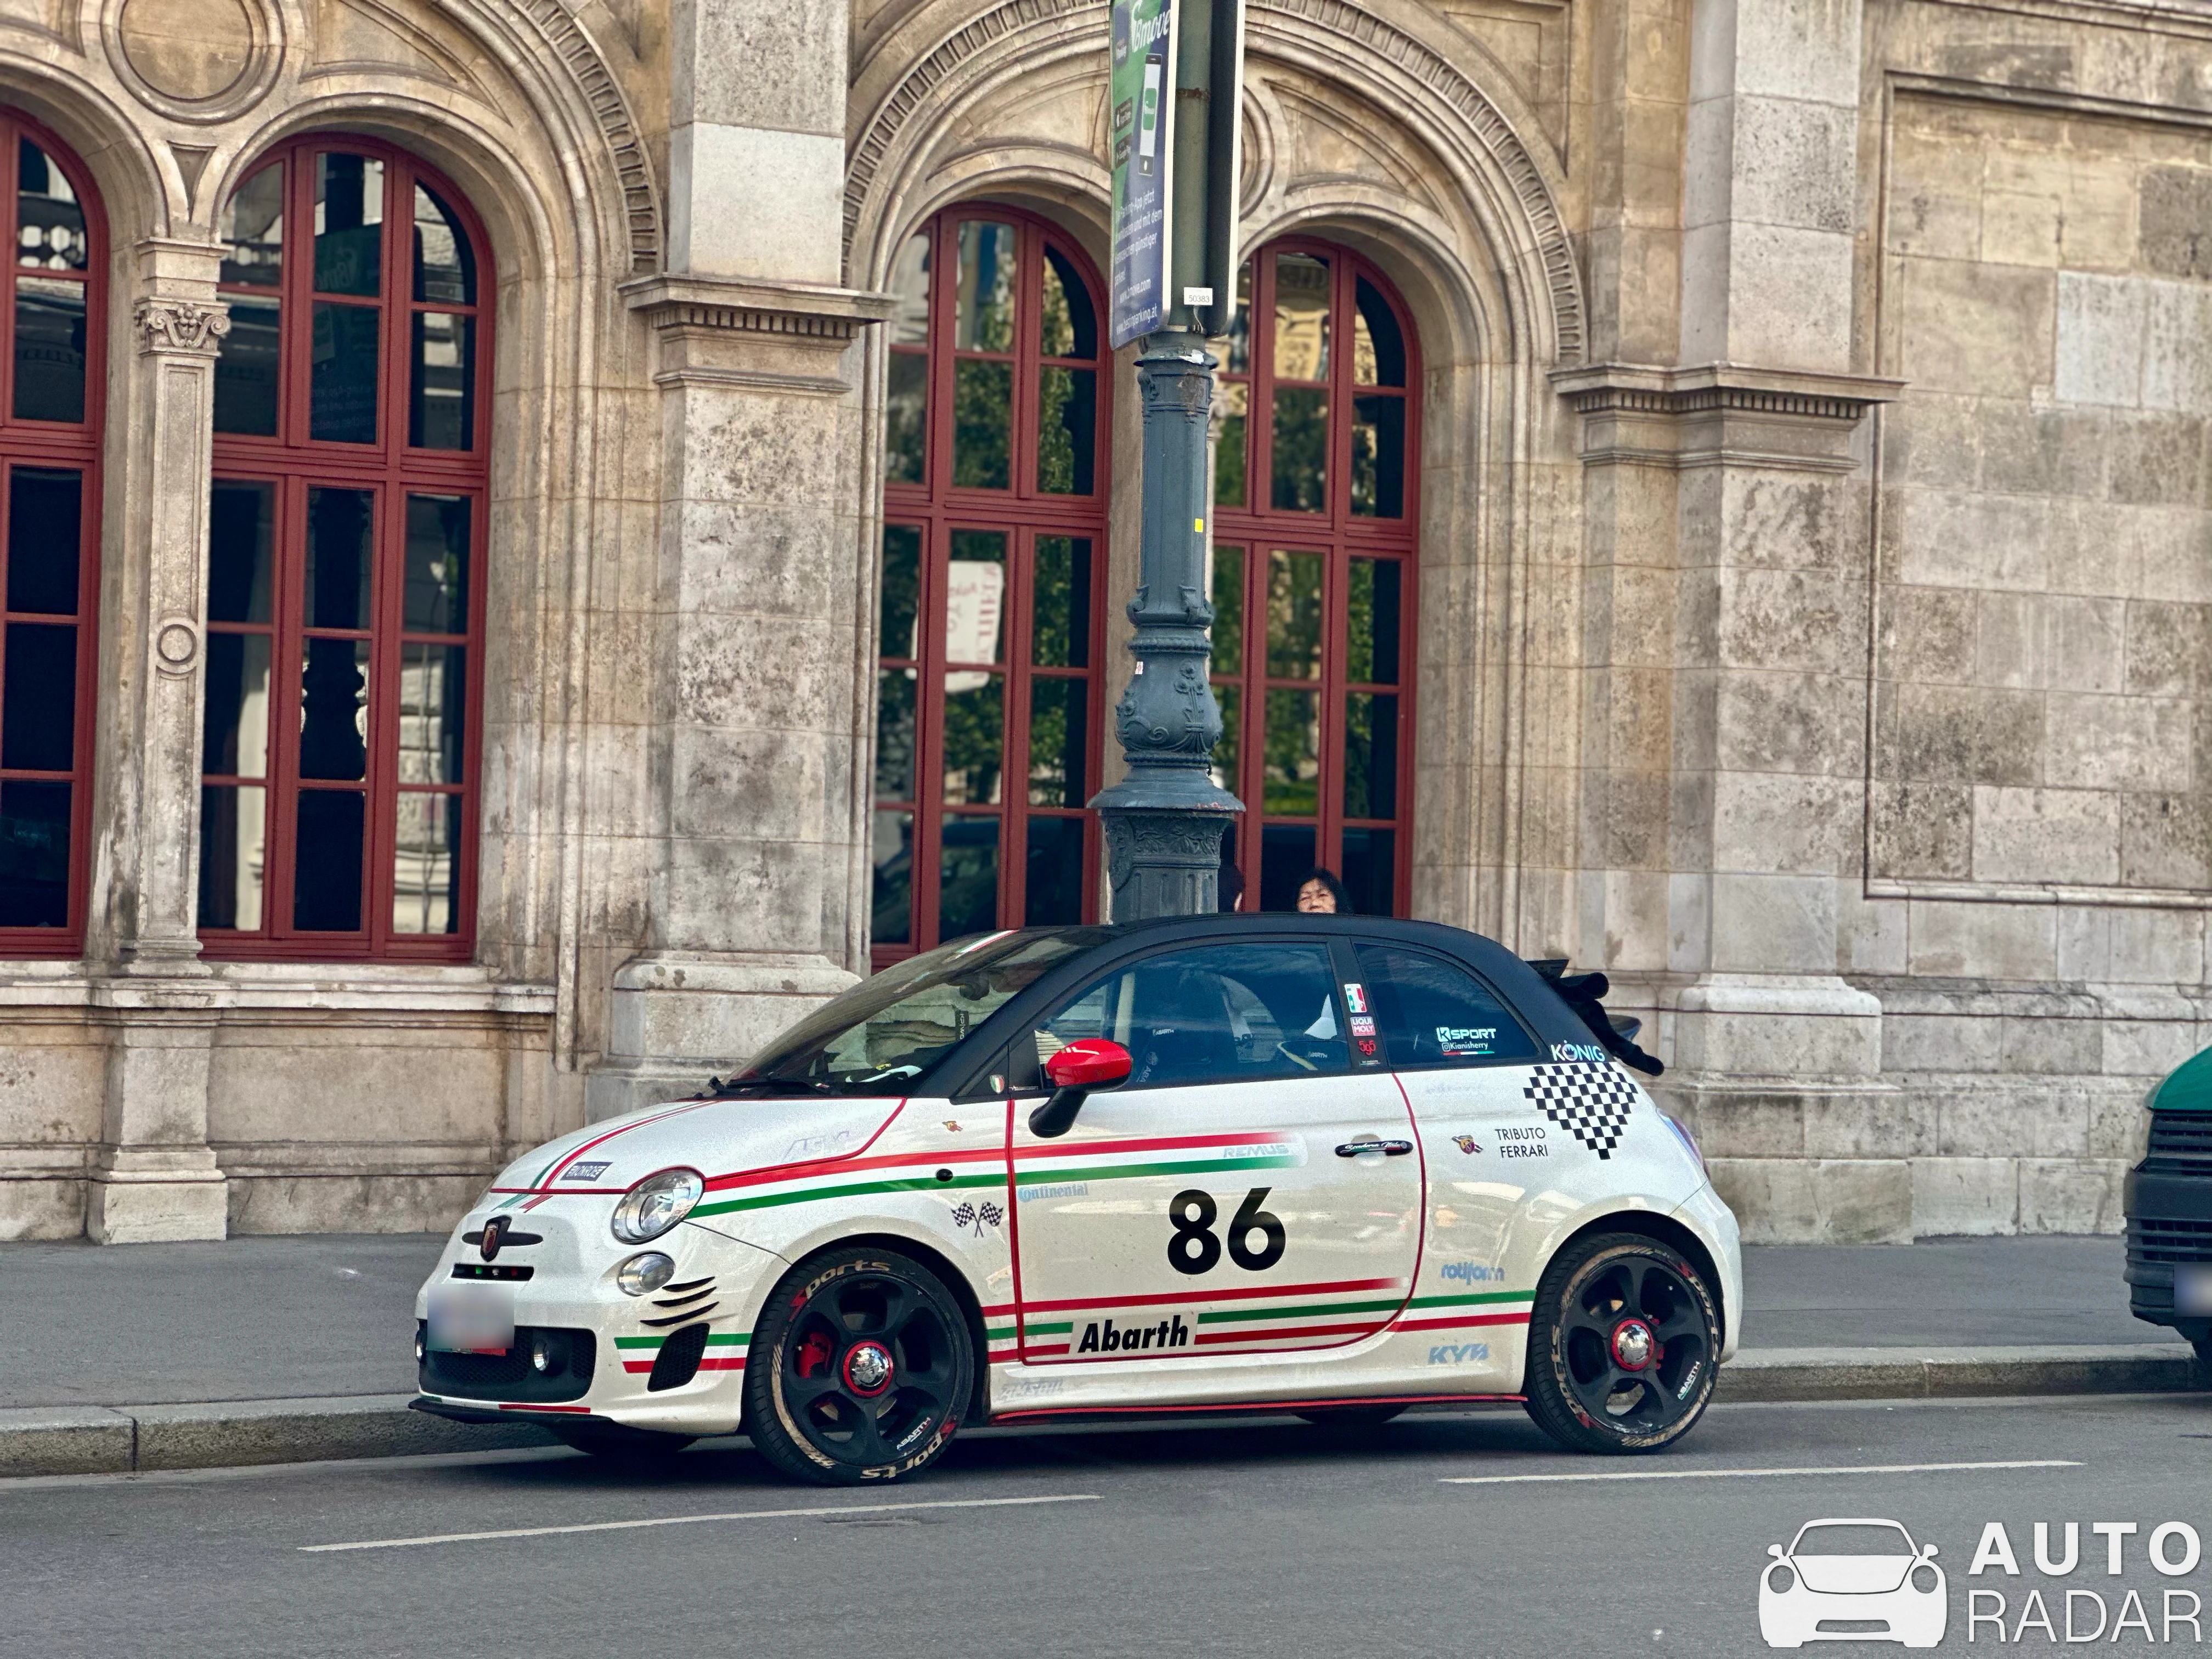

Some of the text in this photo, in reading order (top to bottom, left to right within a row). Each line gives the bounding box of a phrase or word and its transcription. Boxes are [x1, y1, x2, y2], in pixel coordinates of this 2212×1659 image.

[1151, 208, 1162, 224] dem
[1189, 295, 1210, 303] 50383
[1353, 1025, 1374, 1033] MOLY
[1494, 1127, 1546, 1141] TRIBUTO
[1223, 1144, 1289, 1159] REMUS
[1500, 1144, 1549, 1158] FERRARI
[1167, 1187, 1286, 1275] 86
[1077, 1315, 1188, 1353] Abarth
[1677, 1361, 1700, 1400] ABARTH
[896, 1417, 931, 1450] ABARTH
